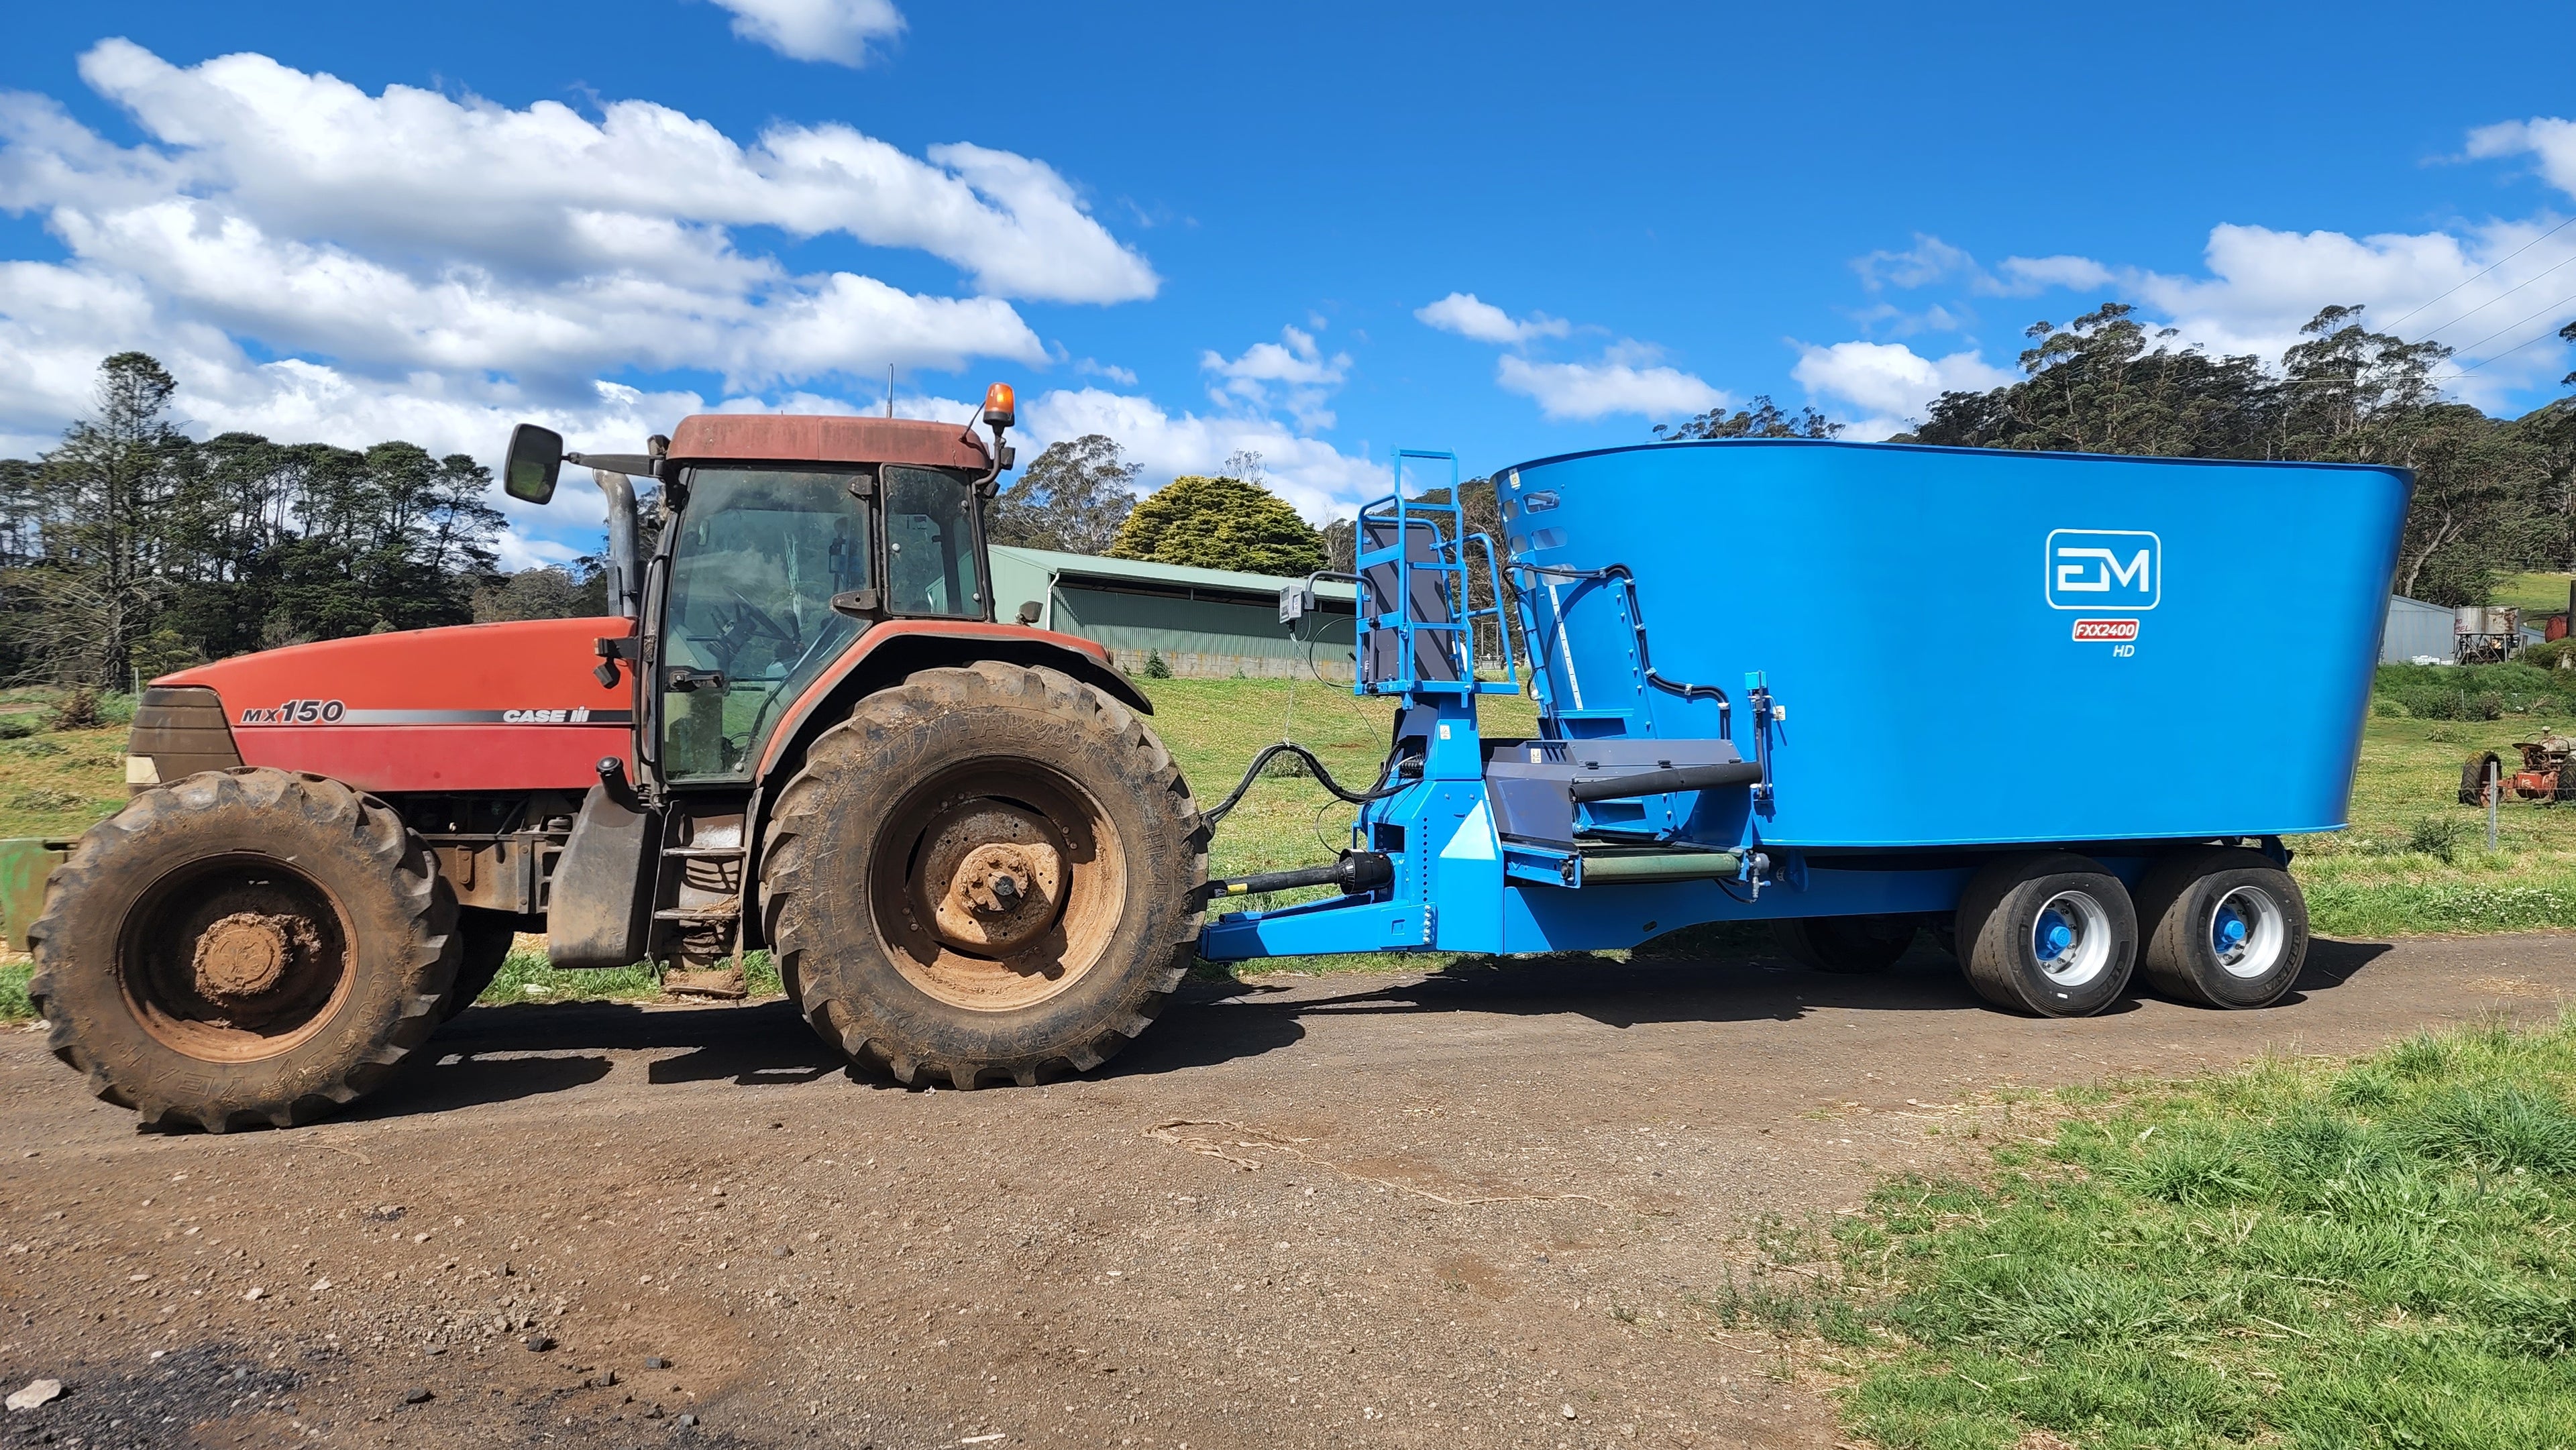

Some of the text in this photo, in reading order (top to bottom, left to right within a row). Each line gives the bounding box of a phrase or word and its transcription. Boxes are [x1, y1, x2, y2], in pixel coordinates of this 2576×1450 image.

[2076, 624, 2135, 637] FXX2400
[2112, 645, 2135, 657] HD
[241, 700, 345, 724] MX150
[502, 710, 567, 723] CASE
